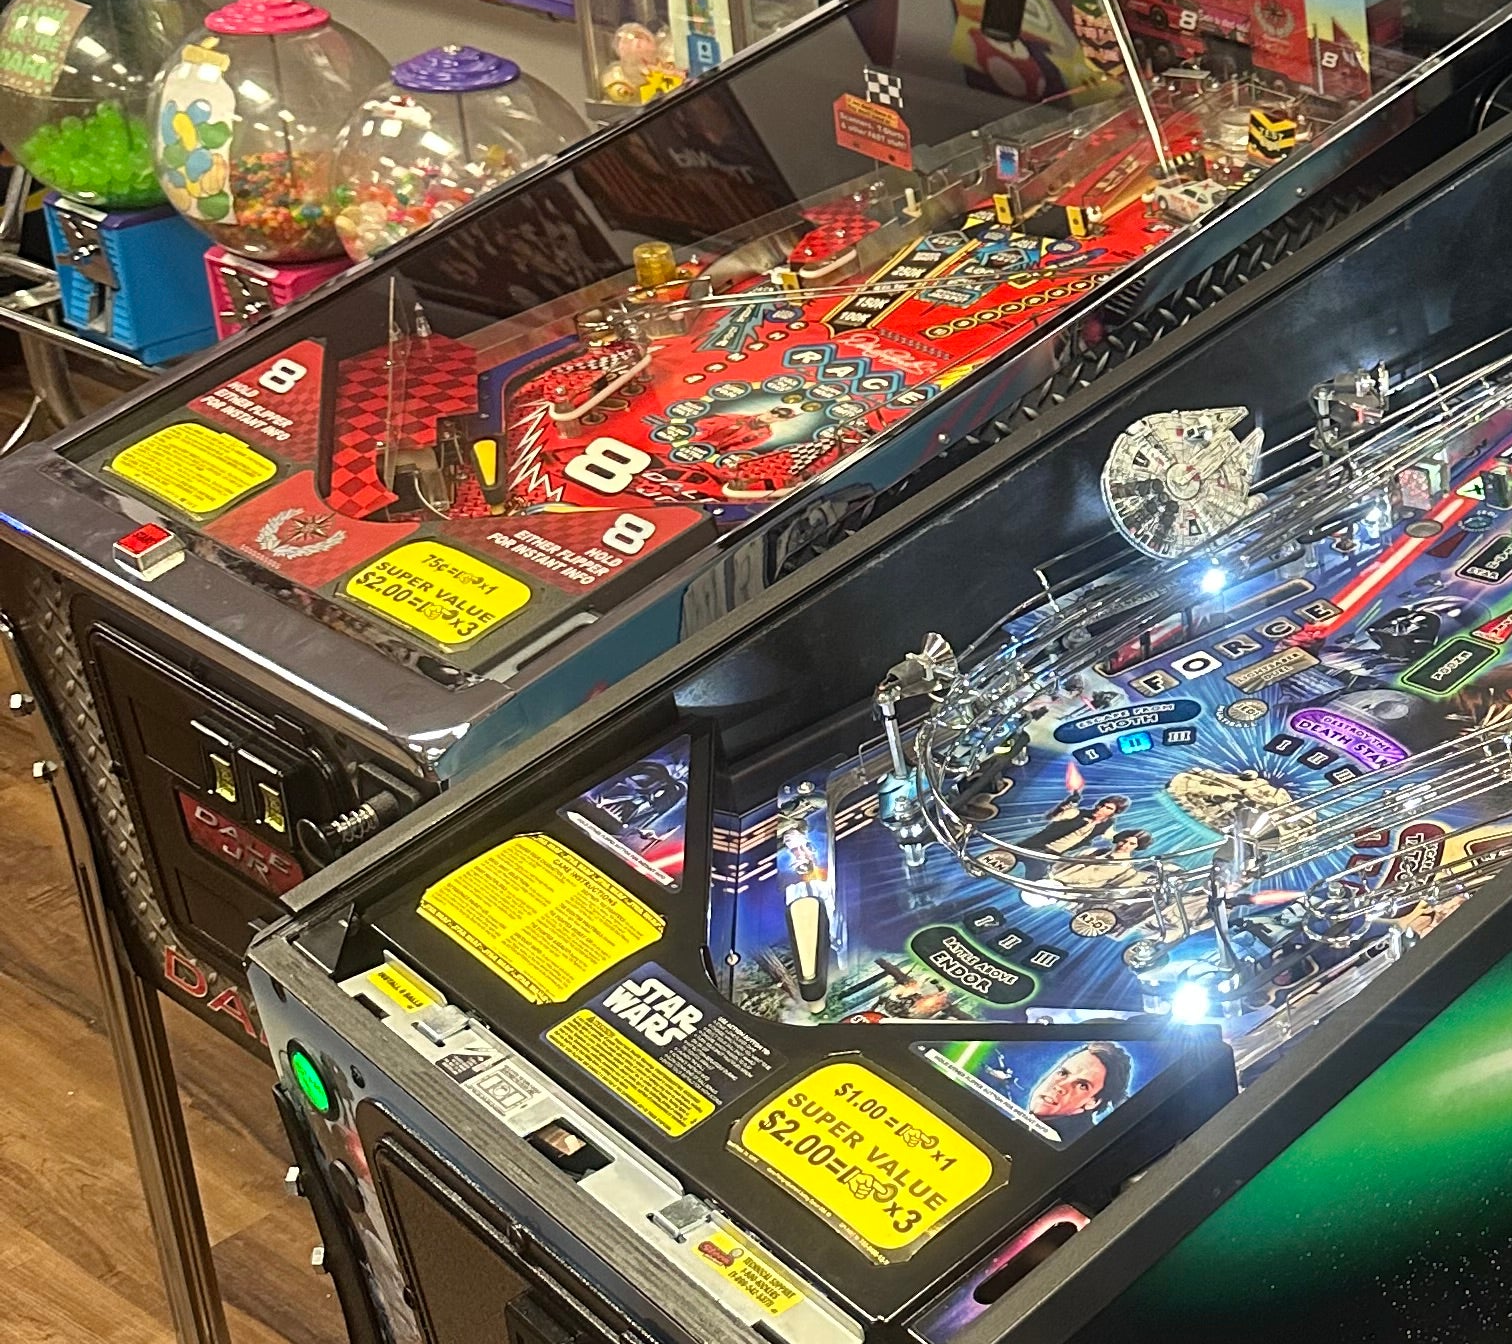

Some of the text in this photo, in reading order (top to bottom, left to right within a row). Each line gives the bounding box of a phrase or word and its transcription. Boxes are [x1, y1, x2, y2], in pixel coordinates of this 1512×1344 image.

[1179, 11, 1198, 31] 8
[227, 381, 260, 398] HOLD
[259, 358, 307, 394] 8
[200, 396, 291, 441] FOR INSTANT INFO
[214, 388, 294, 428] EITHER FLIPPER
[564, 437, 651, 494] 8
[514, 529, 610, 578] EITHER FLIPPER
[602, 513, 656, 555] 8
[486, 532, 595, 586] FOR INSTANT INFO
[584, 547, 624, 568] HOLD
[376, 561, 496, 624] SUPER VALUE
[479, 582, 499, 596] x1
[451, 616, 480, 639] x3
[1236, 653, 1301, 684] LIGHTSABER
[1076, 702, 1175, 730] ESCAPE FROM
[1098, 713, 1159, 732] HOTH
[1323, 716, 1392, 752] DESTROY THE
[1299, 720, 1391, 771] DEATH STAR
[194, 805, 292, 874] DALE
[221, 843, 271, 883] JR
[553, 858, 618, 907] GAME INSTRUCTIONS
[982, 854, 1007, 871] HAN
[930, 951, 991, 994] ENDOR
[943, 936, 1019, 986] BATTLE ABOVE
[164, 945, 269, 1047] DA
[403, 990, 423, 1008] BALLS
[602, 985, 688, 1047] WARS
[622, 978, 703, 1035] STAR
[934, 1054, 1048, 1133] HOLD EITHER FLIPPER BUTTON FOR INSTANT INFO
[834, 1082, 958, 1172] $1.00 x1
[788, 1092, 865, 1149] SUPER
[867, 1146, 948, 1212] VALUE
[883, 1201, 923, 1234] x3
[742, 1255, 796, 1300] TECHNICAL SUPPORT
